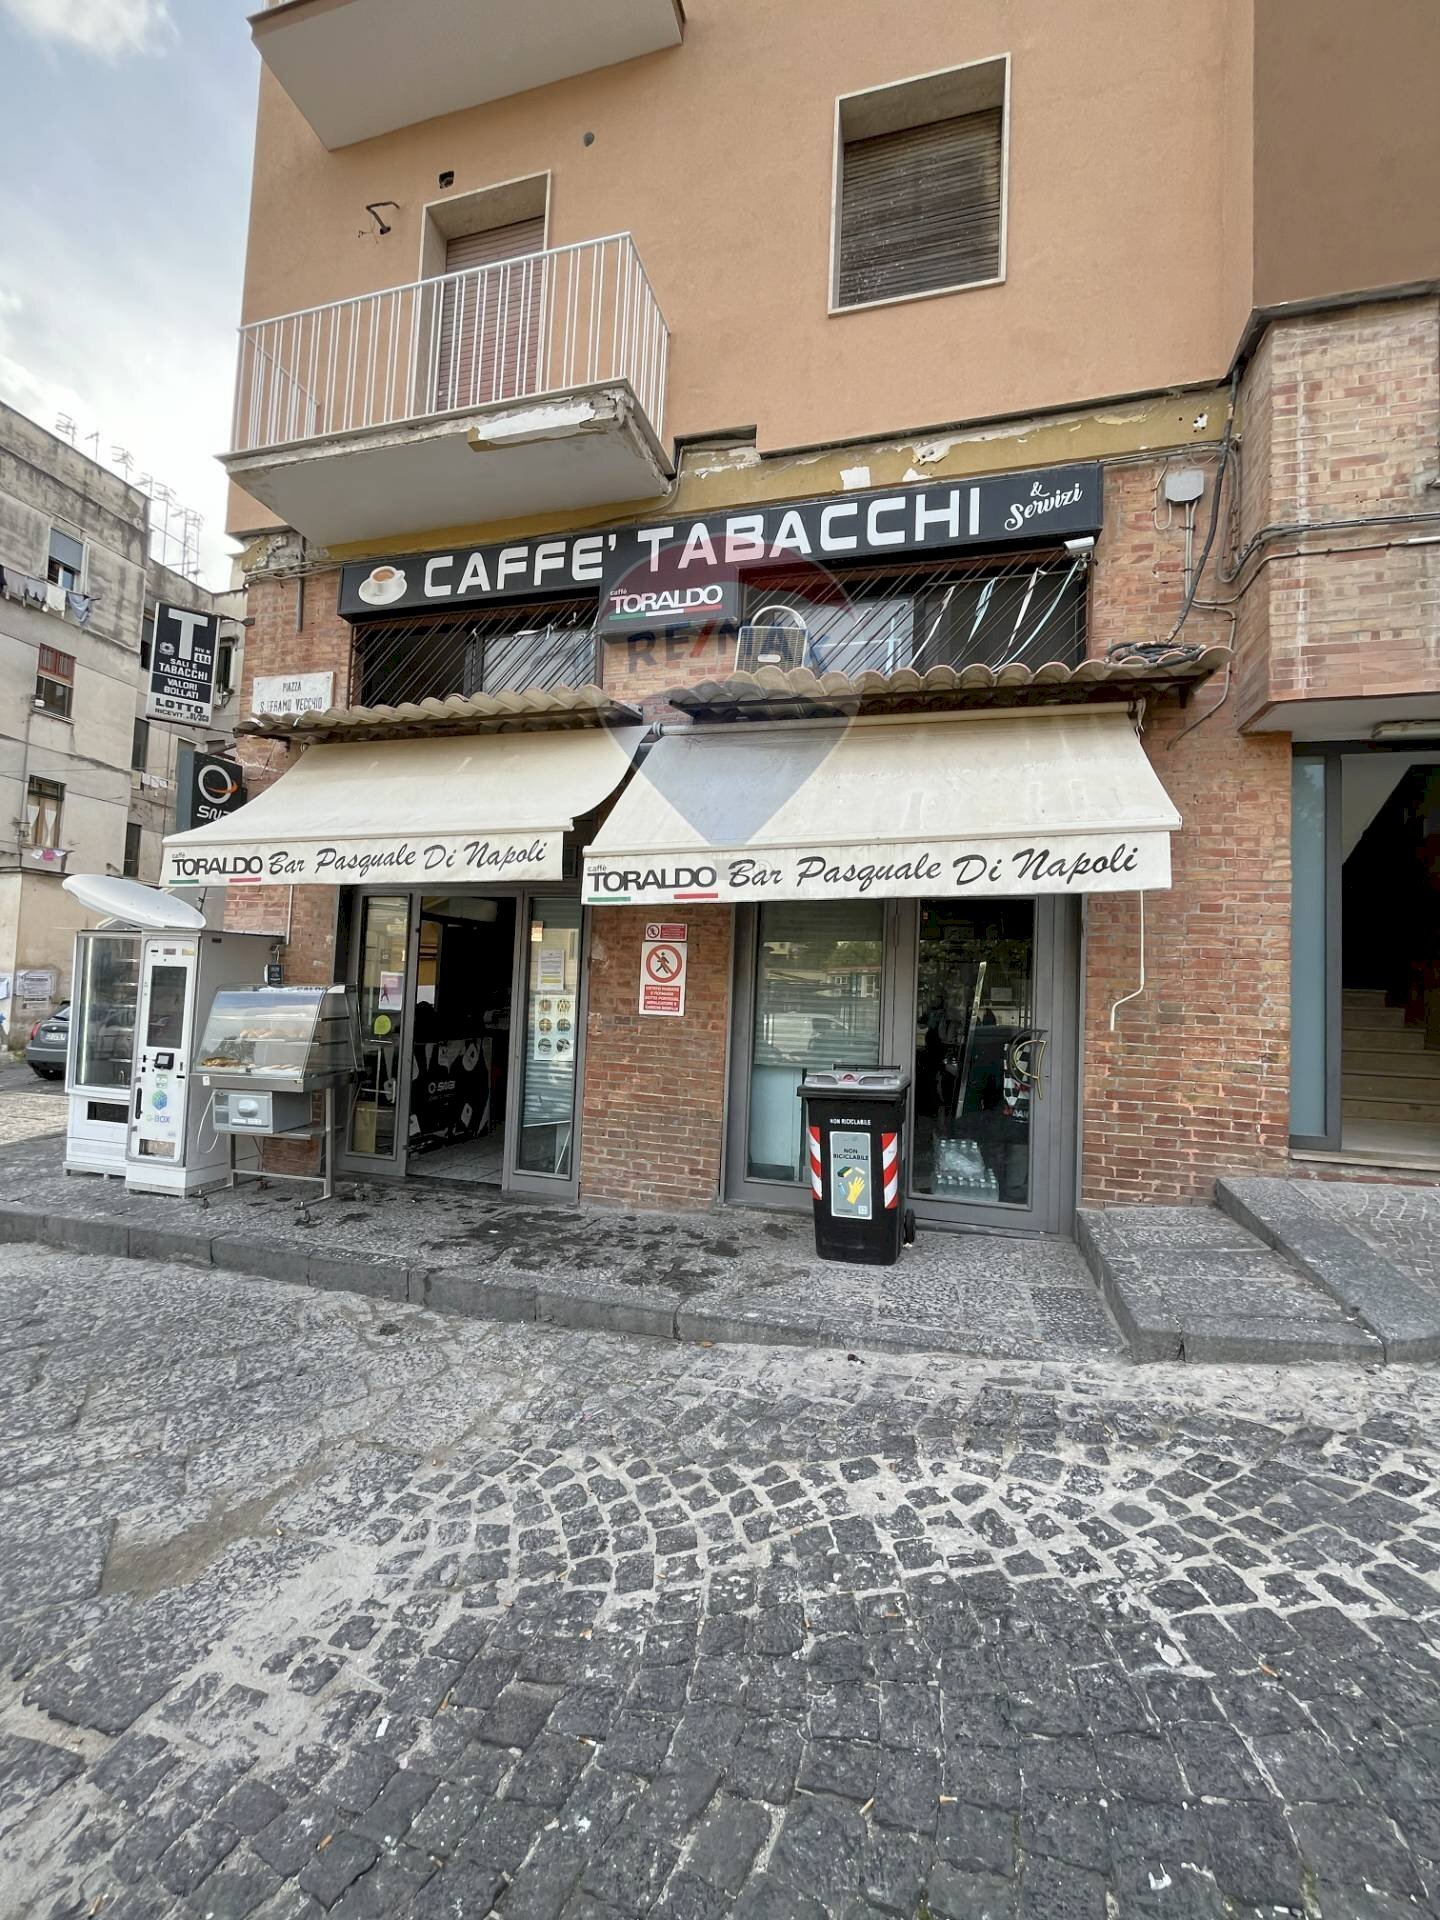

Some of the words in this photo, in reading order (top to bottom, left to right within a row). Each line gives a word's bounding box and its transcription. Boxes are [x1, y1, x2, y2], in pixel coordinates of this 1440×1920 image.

[1030, 481, 1050, 496] &
[1004, 482, 1083, 531] Servizi
[424, 533, 617, 598] CAFFE'
[637, 487, 980, 573] TABACCHI
[609, 585, 723, 614] TORALDO
[168, 608, 208, 660] T
[159, 662, 208, 681] TABACCHI
[170, 658, 189, 667] SALI
[163, 685, 199, 700] BOLLATI
[167, 677, 198, 691] VALORI
[282, 681, 302, 692] PIAZZA
[155, 697, 204, 714] LOTTO
[172, 856, 263, 876] TORALDO
[268, 850, 306, 875] Bar
[314, 843, 417, 877] Pasquale
[424, 844, 457, 870] Di
[463, 839, 547, 871] Napoli
[587, 866, 718, 892] TORALDO
[728, 859, 783, 887] Bar
[796, 852, 942, 892] Pasquale
[952, 854, 1002, 886] Di
[1011, 843, 1139, 885] Napoli
